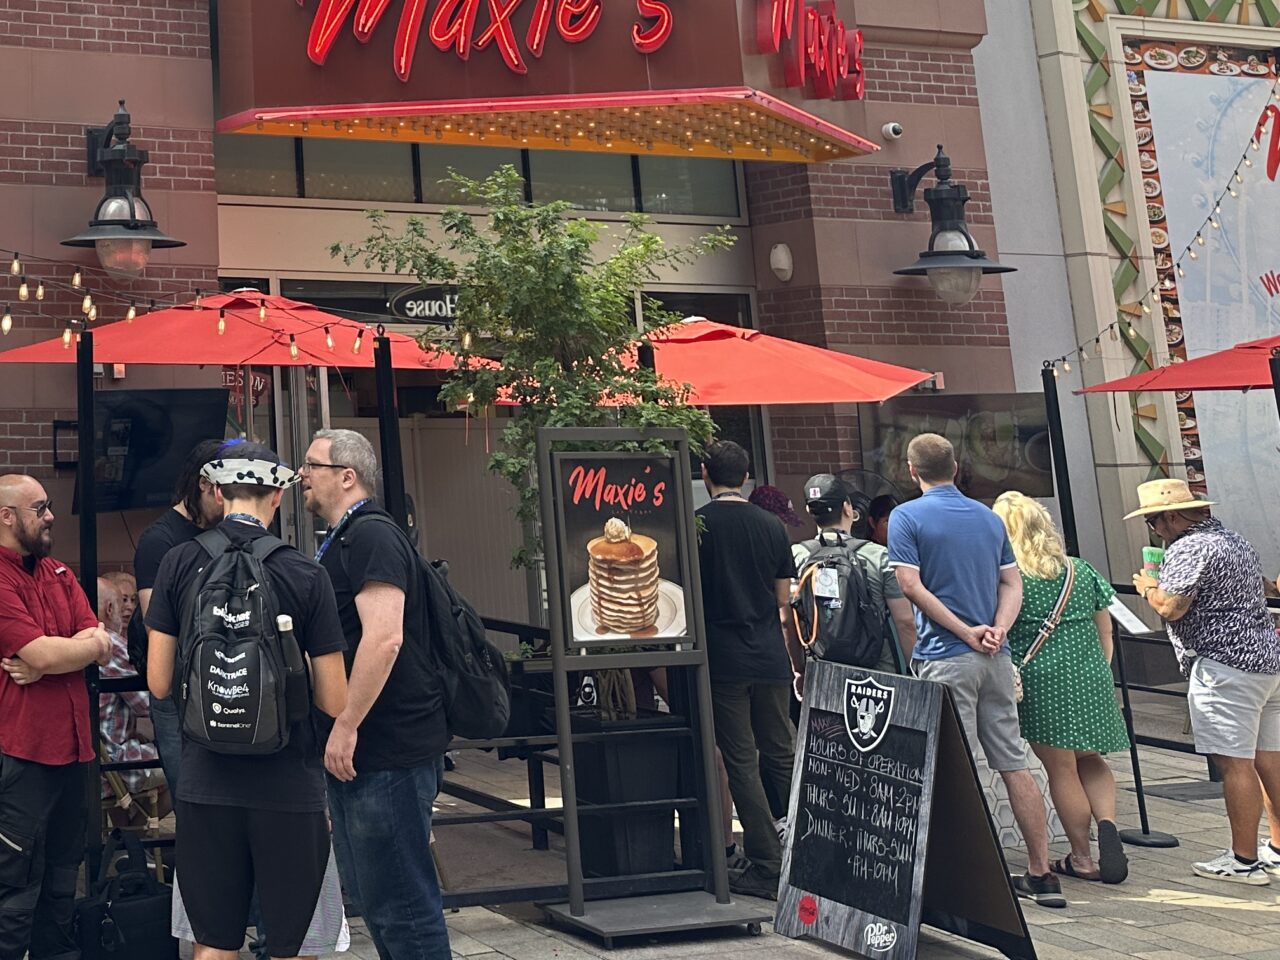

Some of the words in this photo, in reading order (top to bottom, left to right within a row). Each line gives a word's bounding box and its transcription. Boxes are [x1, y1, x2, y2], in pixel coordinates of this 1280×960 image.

[568, 465, 666, 511] Maxie's
[207, 680, 250, 696] KnowBe4
[850, 684, 889, 700] RAIDERS
[809, 733, 848, 760] HOURS
[866, 923, 895, 948] Pepper
[875, 922, 888, 936] Dr
